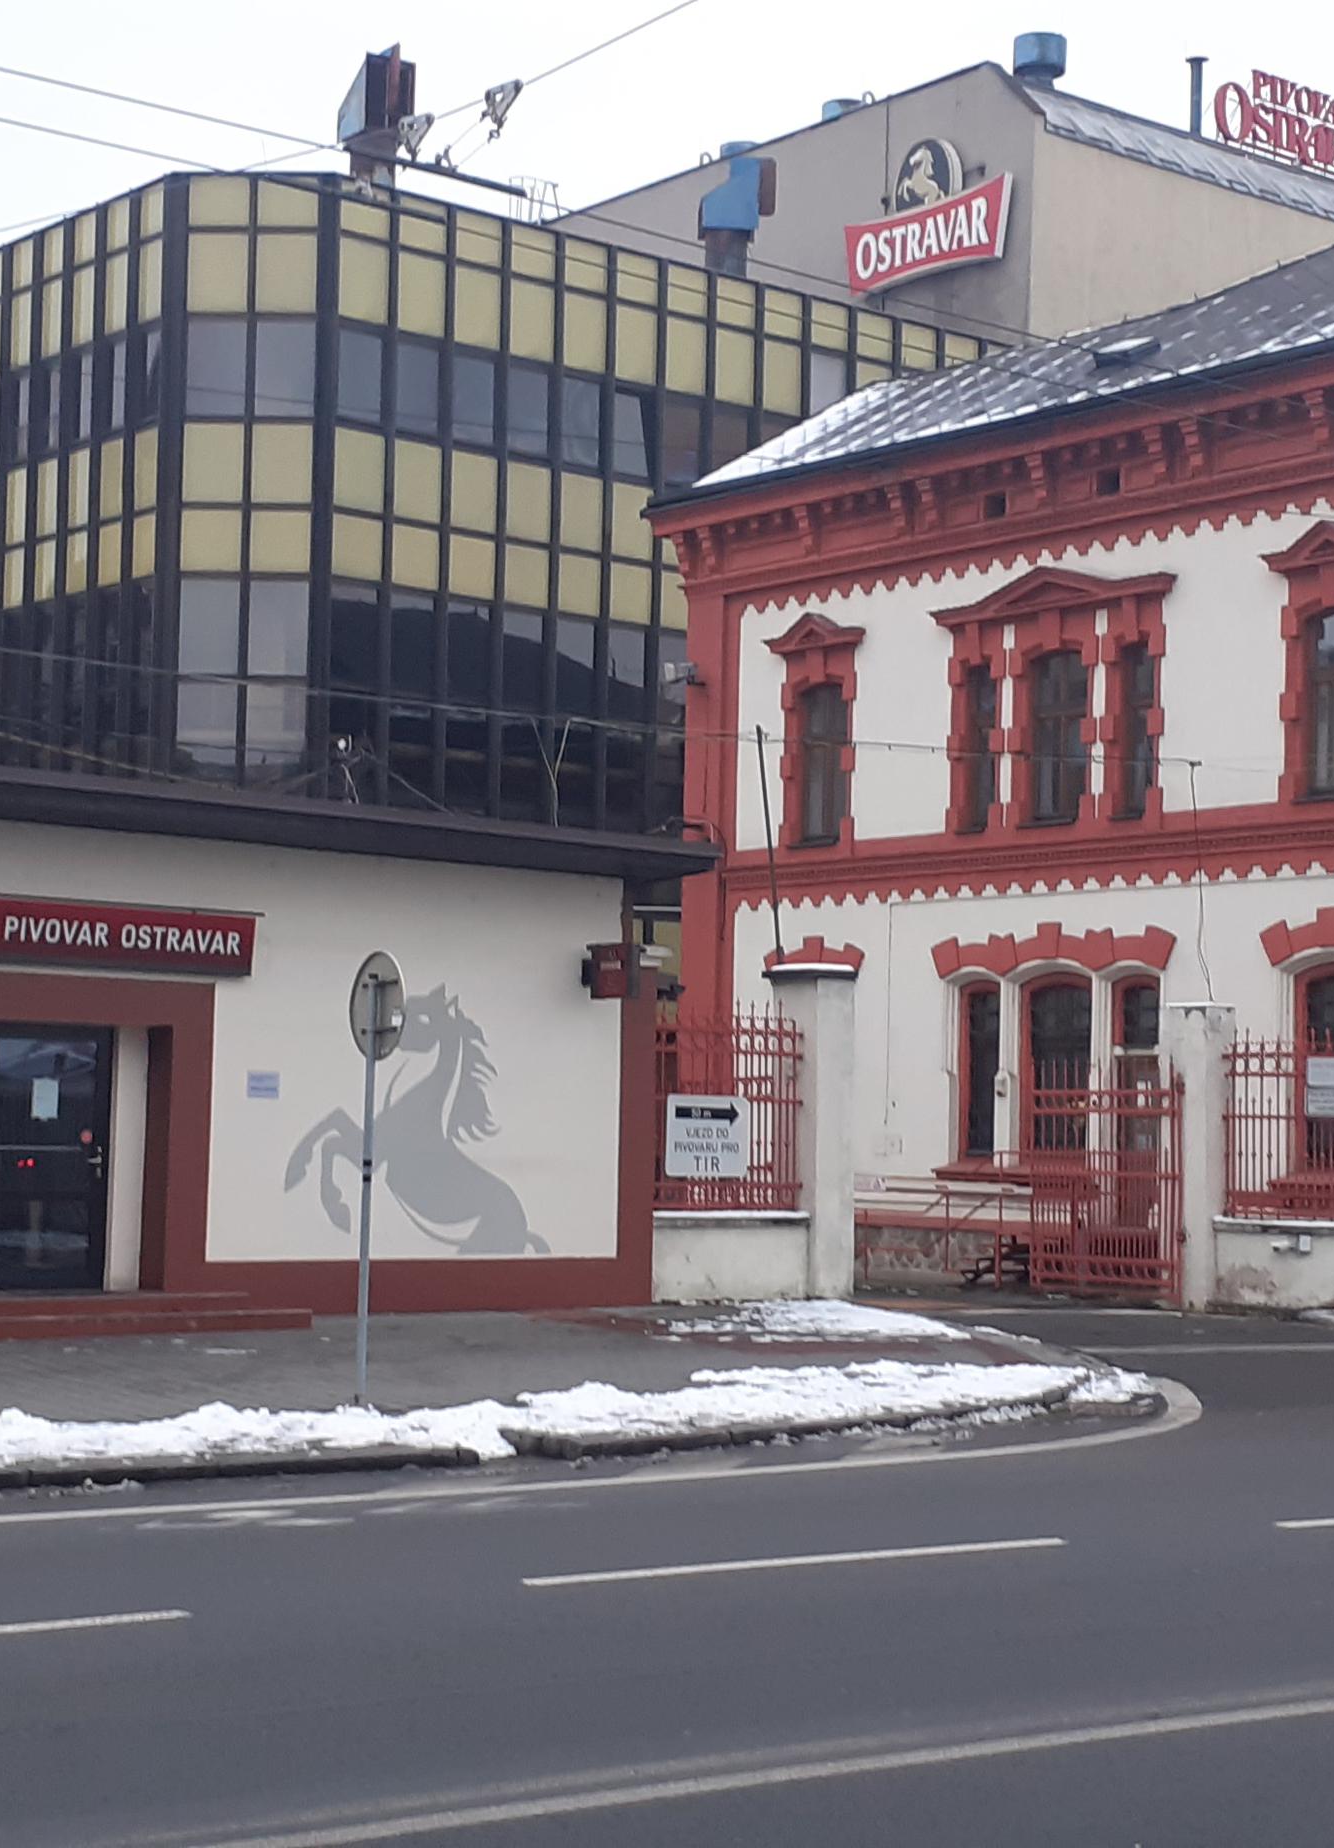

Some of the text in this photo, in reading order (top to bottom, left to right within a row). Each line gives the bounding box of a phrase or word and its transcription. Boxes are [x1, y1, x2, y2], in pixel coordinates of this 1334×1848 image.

[855, 196, 990, 280] OSTRAVAR
[3, 915, 109, 947] PIVOVAR
[120, 923, 241, 956] OSTRAVAR
[685, 1127, 729, 1139] VJEZD DO
[674, 1141, 740, 1154] PIVOVARU PRO
[693, 1155, 721, 1173] TIR
